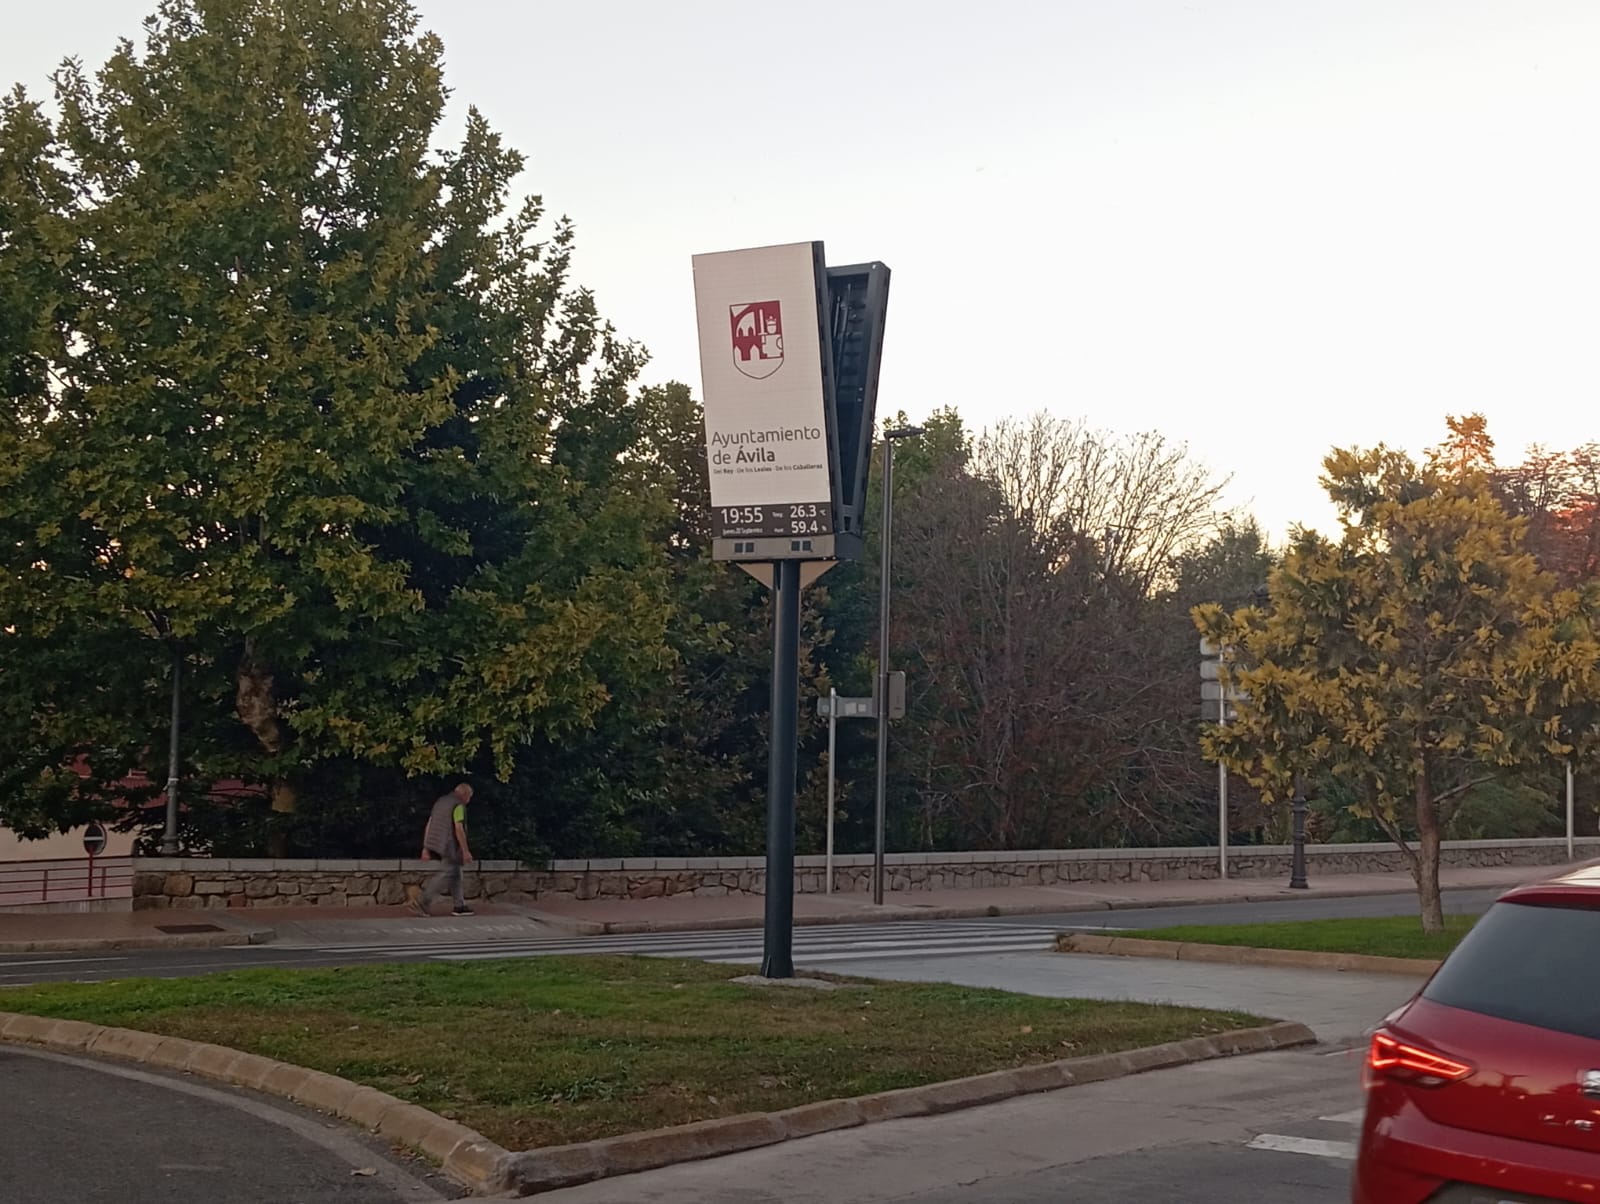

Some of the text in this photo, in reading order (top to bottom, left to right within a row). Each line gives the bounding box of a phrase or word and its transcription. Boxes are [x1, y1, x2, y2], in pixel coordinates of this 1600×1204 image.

[712, 426, 821, 448] Ayuntamiento
[712, 445, 776, 465] de Ávila
[792, 463, 823, 471] Caballeros
[720, 507, 764, 524] 19:55
[790, 504, 817, 518] 26.3
[791, 520, 818, 534] 59.4
